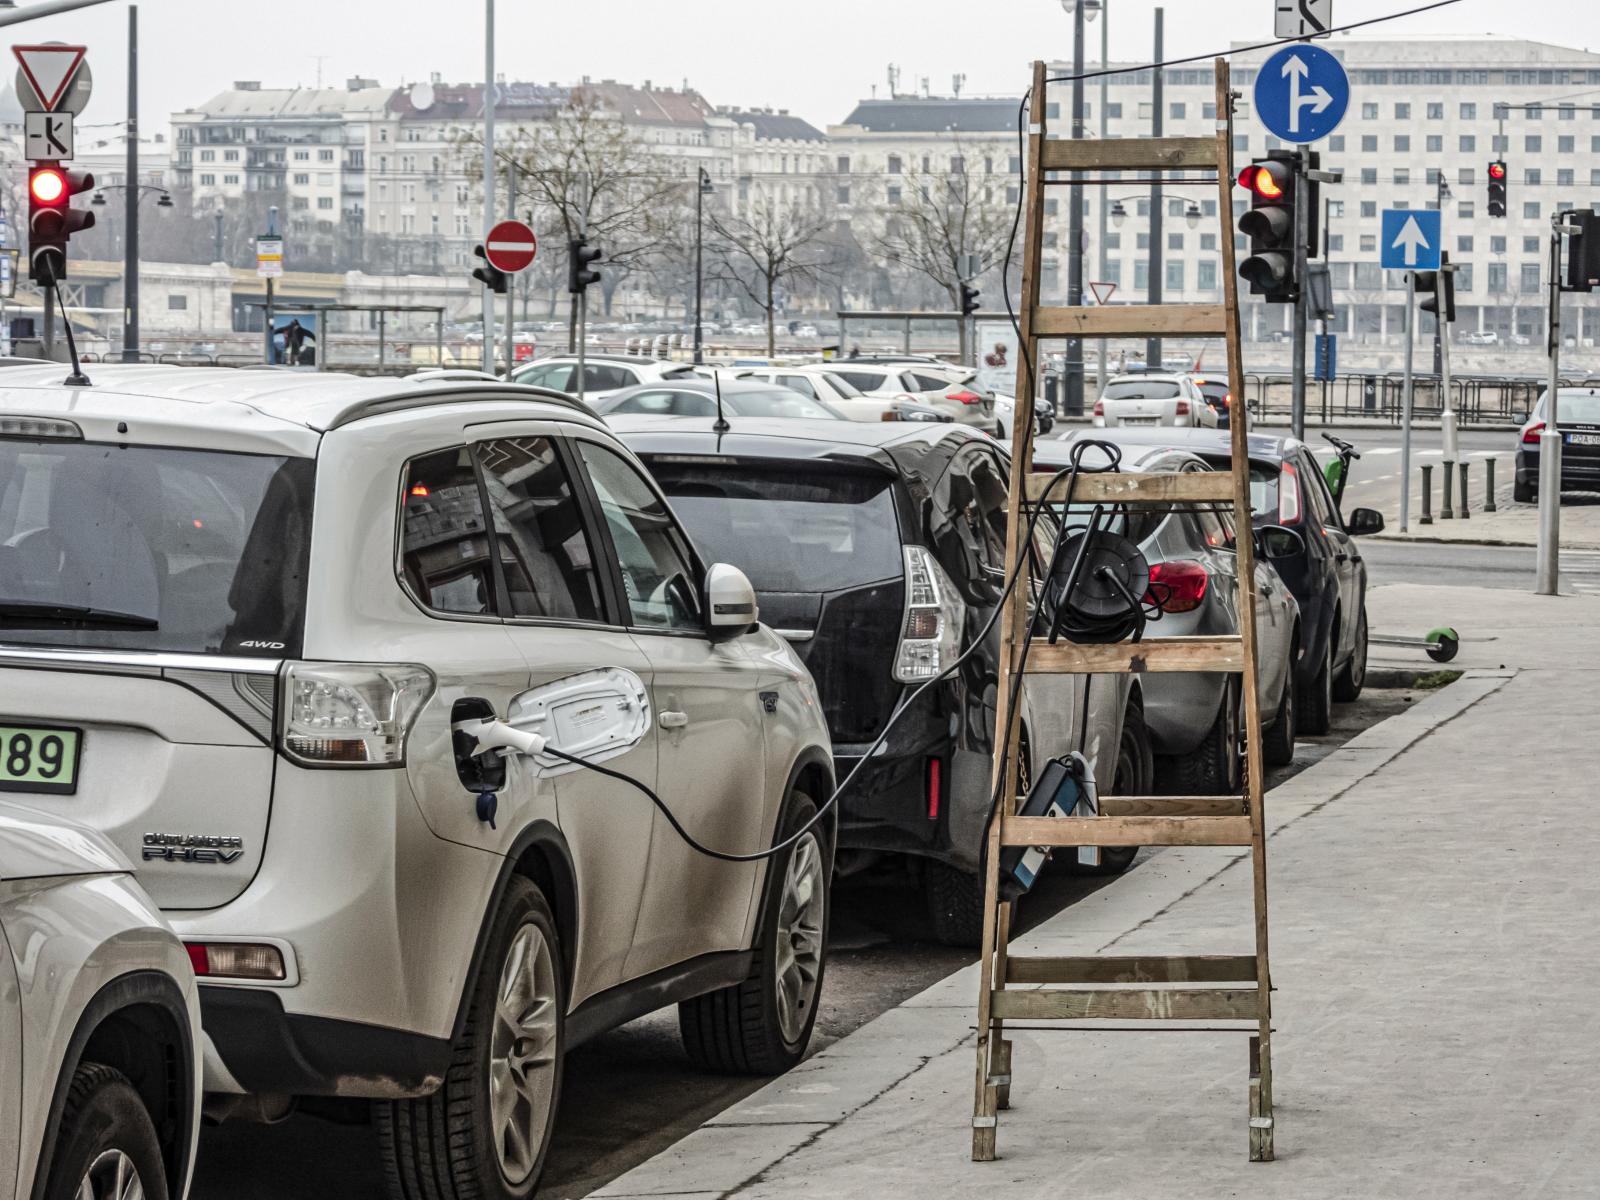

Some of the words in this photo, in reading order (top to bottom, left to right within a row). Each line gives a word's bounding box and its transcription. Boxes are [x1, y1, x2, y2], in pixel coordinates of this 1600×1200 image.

[239, 640, 286, 649] 4WD
[0, 732, 64, 778] 89
[143, 832, 243, 848] OUTLANDER
[142, 845, 244, 864] PHEV
